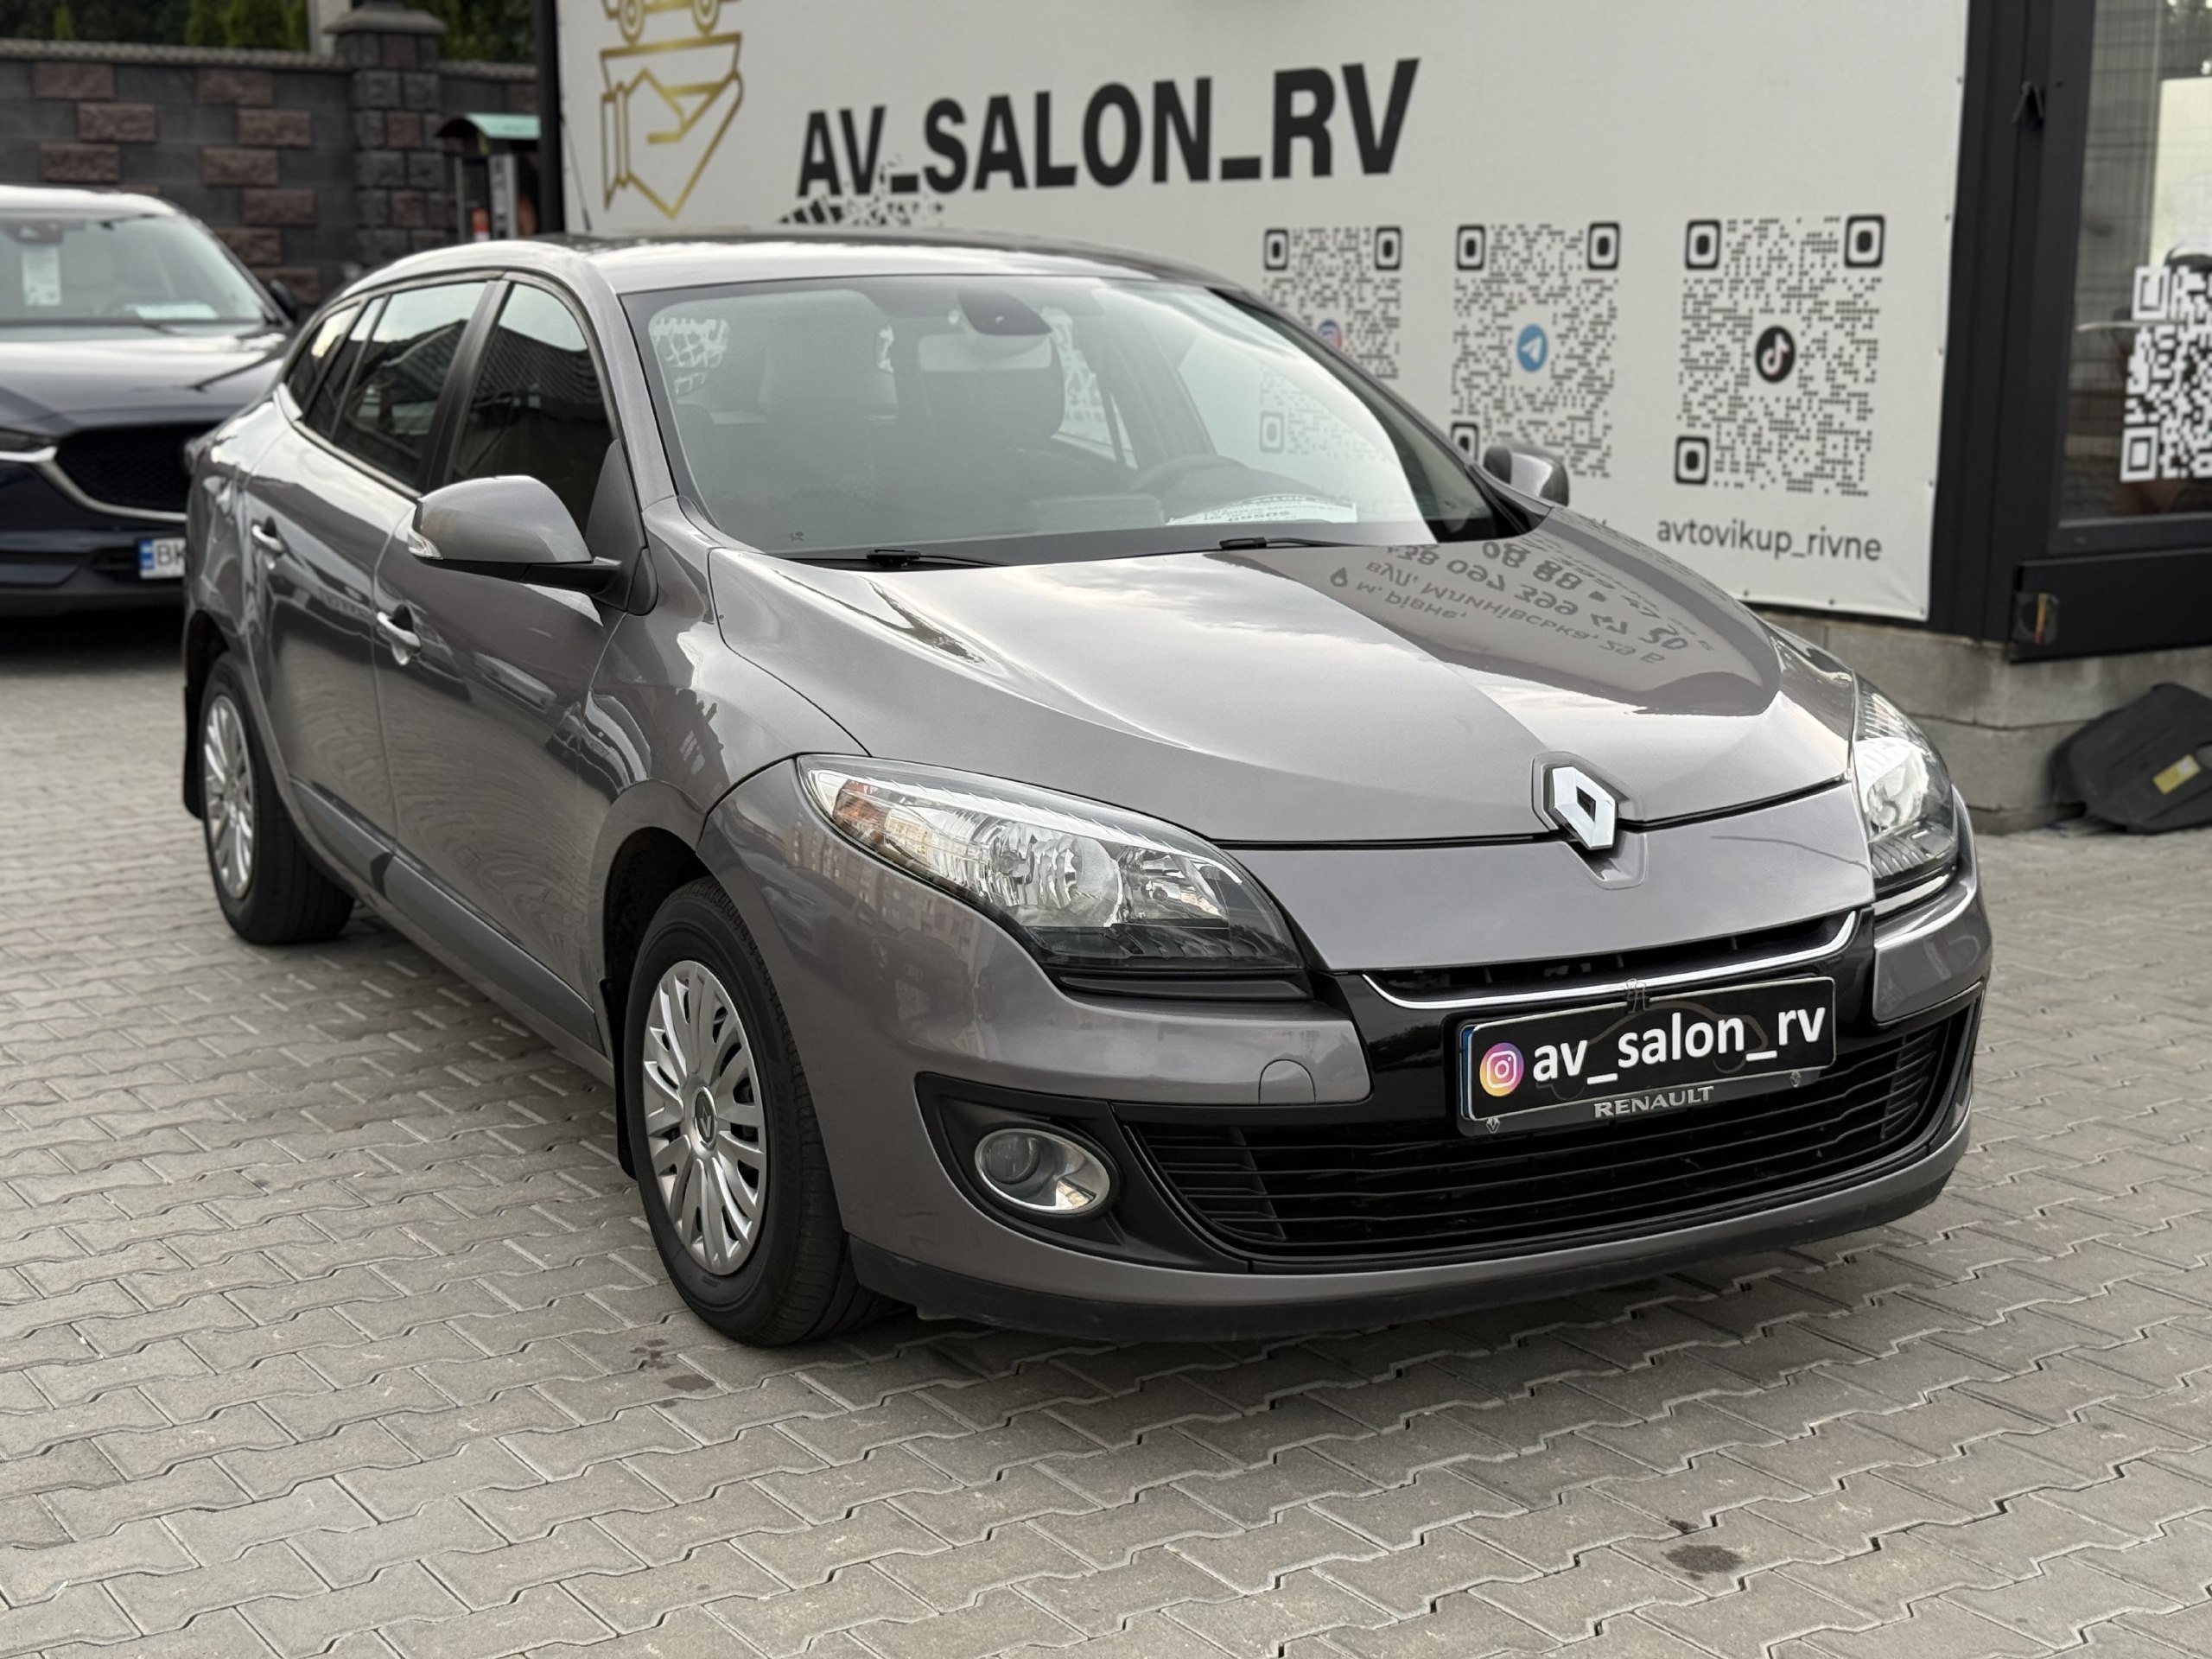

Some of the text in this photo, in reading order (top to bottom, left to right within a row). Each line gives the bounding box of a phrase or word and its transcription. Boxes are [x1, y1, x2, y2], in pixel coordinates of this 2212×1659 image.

[797, 57, 1421, 197] AV_SALON_RV
[1656, 518, 1883, 562] avtovikup_rivne
[1533, 1007, 1827, 1086] av_salon_rv
[1593, 1085, 1714, 1119] RENAULT
